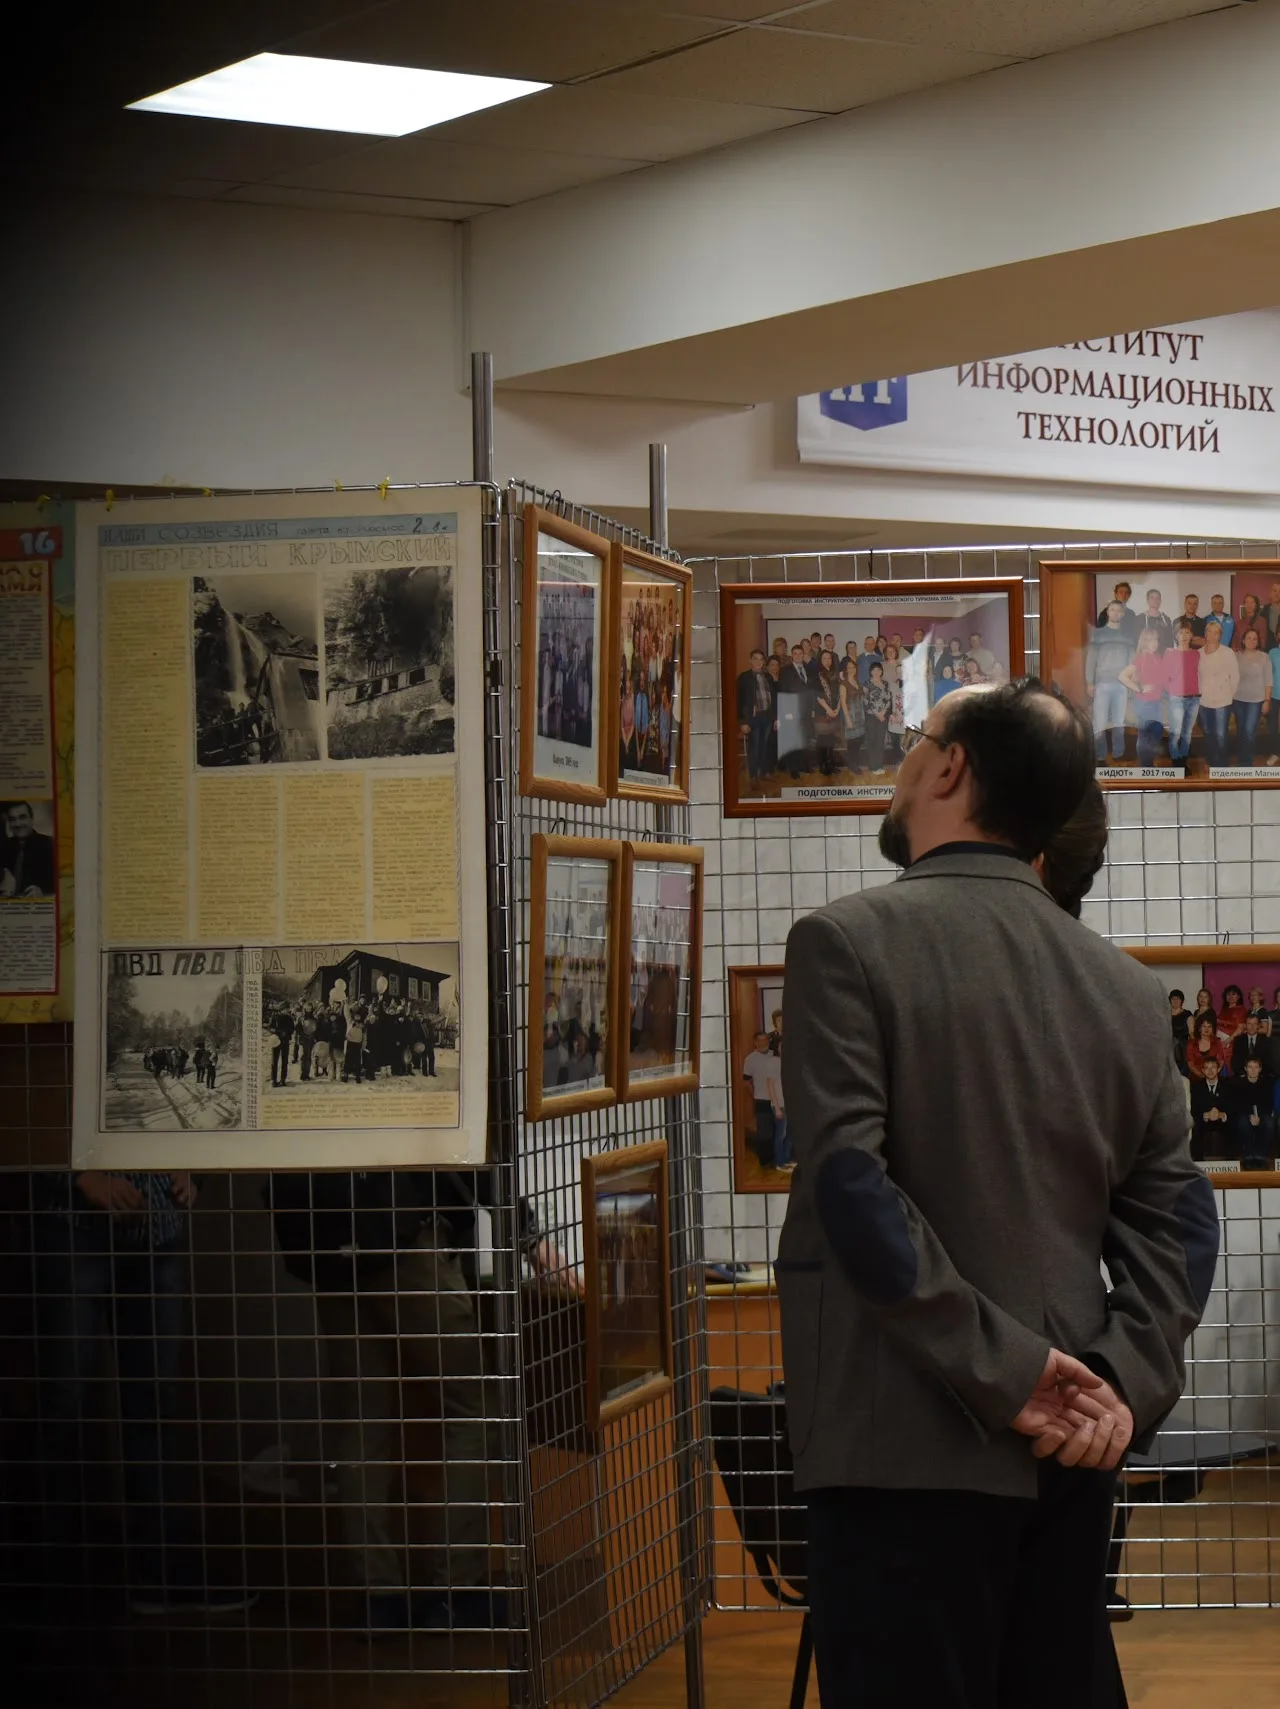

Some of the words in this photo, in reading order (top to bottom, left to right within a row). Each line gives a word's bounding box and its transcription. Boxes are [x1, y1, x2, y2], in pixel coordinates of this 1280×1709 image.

[1056, 329, 1204, 364] ТИТУТ
[957, 362, 1276, 413] ИНФОРМАЦИОННЫХ
[1016, 411, 1221, 454] ТЕХНОЛОГИЙ
[19, 531, 56, 555] 16
[1141, 769, 1160, 777] 2017
[1161, 770, 1176, 779] год
[1211, 769, 1252, 779] отделение
[798, 789, 853, 798] ПОДГОТОВКА
[857, 787, 894, 796] ИНСТРУК
[114, 952, 164, 976] ПВД
[172, 951, 226, 975] ПВД
[236, 949, 286, 974] ПВД
[1204, 1164, 1238, 1173] отовка
